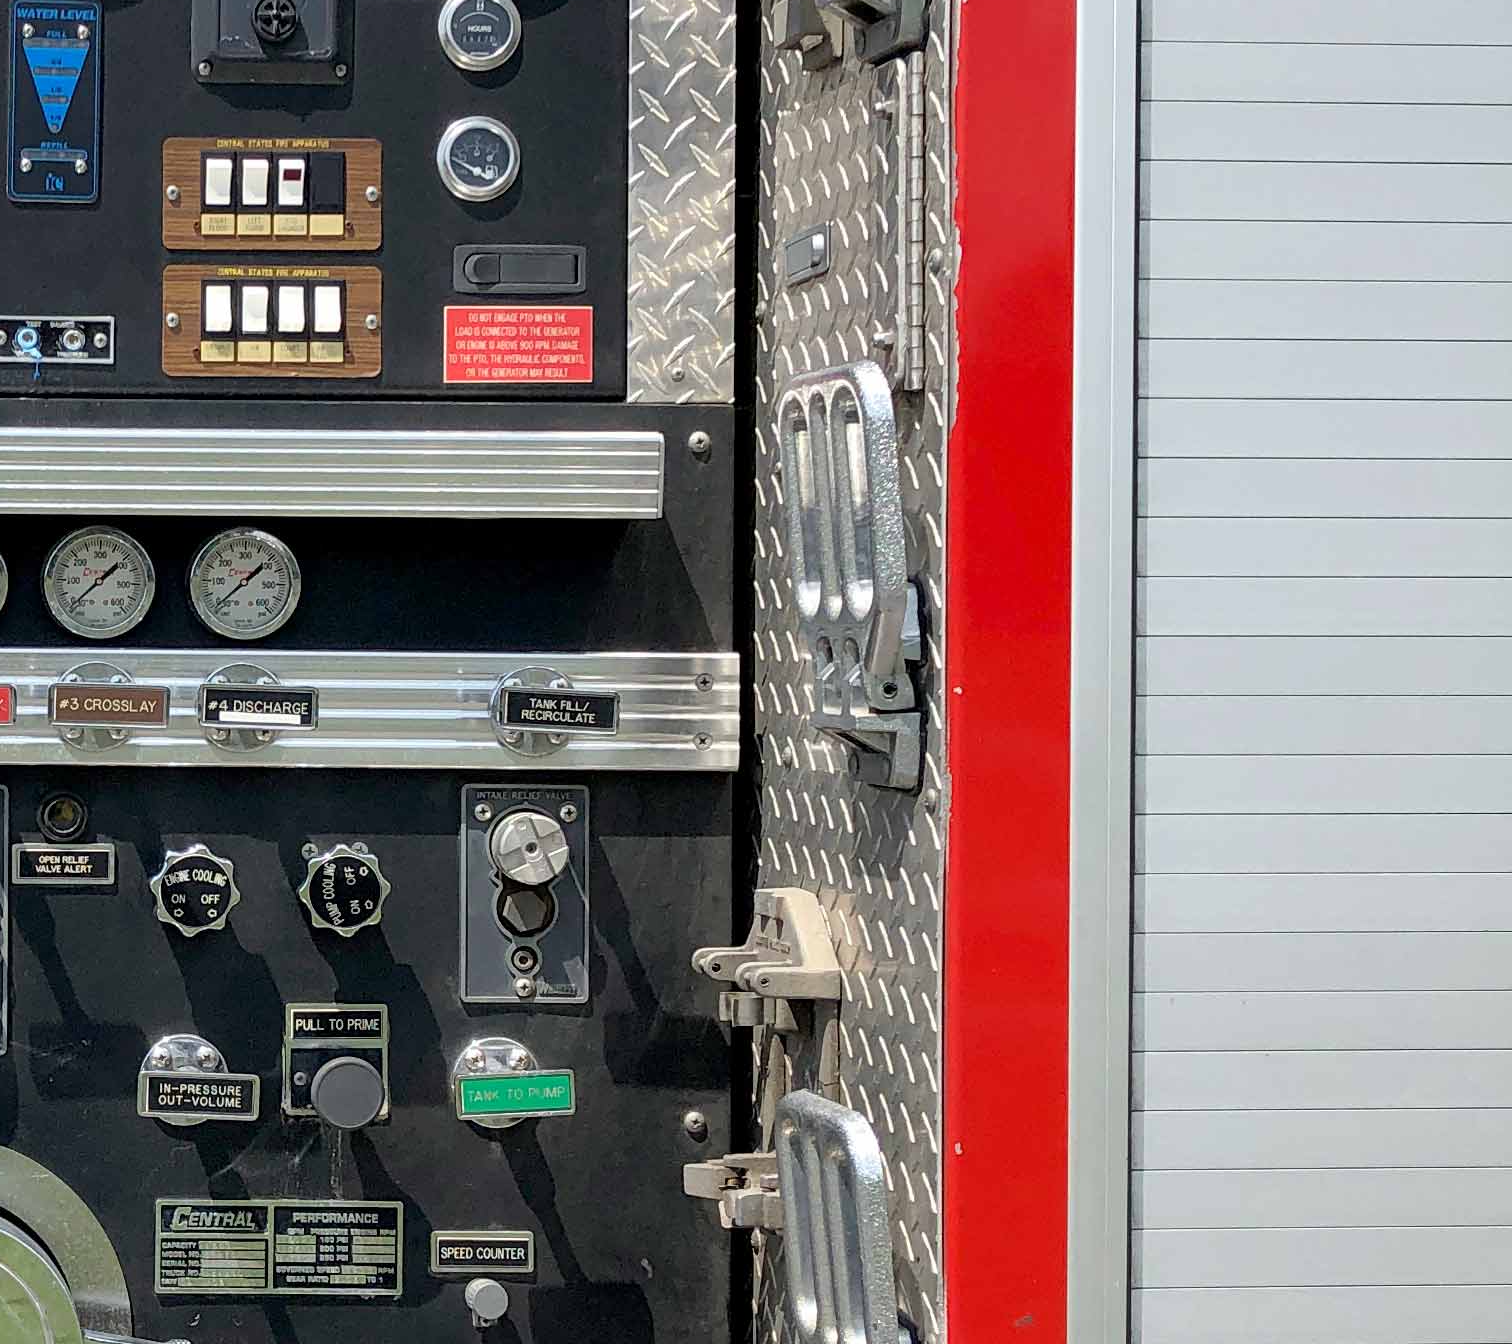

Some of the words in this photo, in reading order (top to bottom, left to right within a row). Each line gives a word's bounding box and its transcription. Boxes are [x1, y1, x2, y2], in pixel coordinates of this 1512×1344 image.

[17, 7, 58, 20] WATER
[60, 9, 97, 21] LEVEL
[468, 25, 492, 33] HOURS
[216, 139, 244, 148] CENTRAL
[248, 139, 273, 148] STATES
[292, 139, 329, 148] APPARATUS
[519, 313, 533, 323] PTO
[59, 698, 79, 711] #3
[83, 698, 158, 713] CROSSLAY
[208, 699, 228, 712] #4
[233, 699, 309, 715] DISCHARGE
[529, 698, 557, 710] TANK
[560, 699, 589, 711] FILL/
[521, 709, 596, 724] RECIRCULATE
[476, 792, 507, 800] INTAKE
[512, 792, 540, 800] RELIEF
[39, 856, 60, 864] OPEN
[62, 856, 89, 865] RELIEF
[35, 865, 62, 873] VALVE
[64, 865, 94, 874] ALERT
[345, 866, 356, 886] OFF
[164, 869, 191, 886] ENGINE
[192, 869, 228, 888] COOLING
[323, 862, 336, 899] COOLING
[171, 894, 186, 904] ON
[201, 894, 220, 905] OFF
[326, 901, 345, 926] PUMP
[351, 899, 361, 915] ON
[295, 1019, 324, 1031] PULL
[329, 1019, 344, 1031] TO
[347, 1019, 380, 1031] PRIME
[159, 1083, 242, 1097] IN-PRESSURE
[467, 1089, 499, 1103] TANK
[507, 1088, 524, 1101] TO
[529, 1085, 566, 1099] PUMP
[158, 1094, 242, 1108] OUT-VOLUME
[170, 1207, 255, 1231] CENTRAL
[292, 1212, 379, 1224] PERFORMANCE
[440, 1246, 473, 1259] SPEED
[476, 1247, 525, 1260] COUNTER
